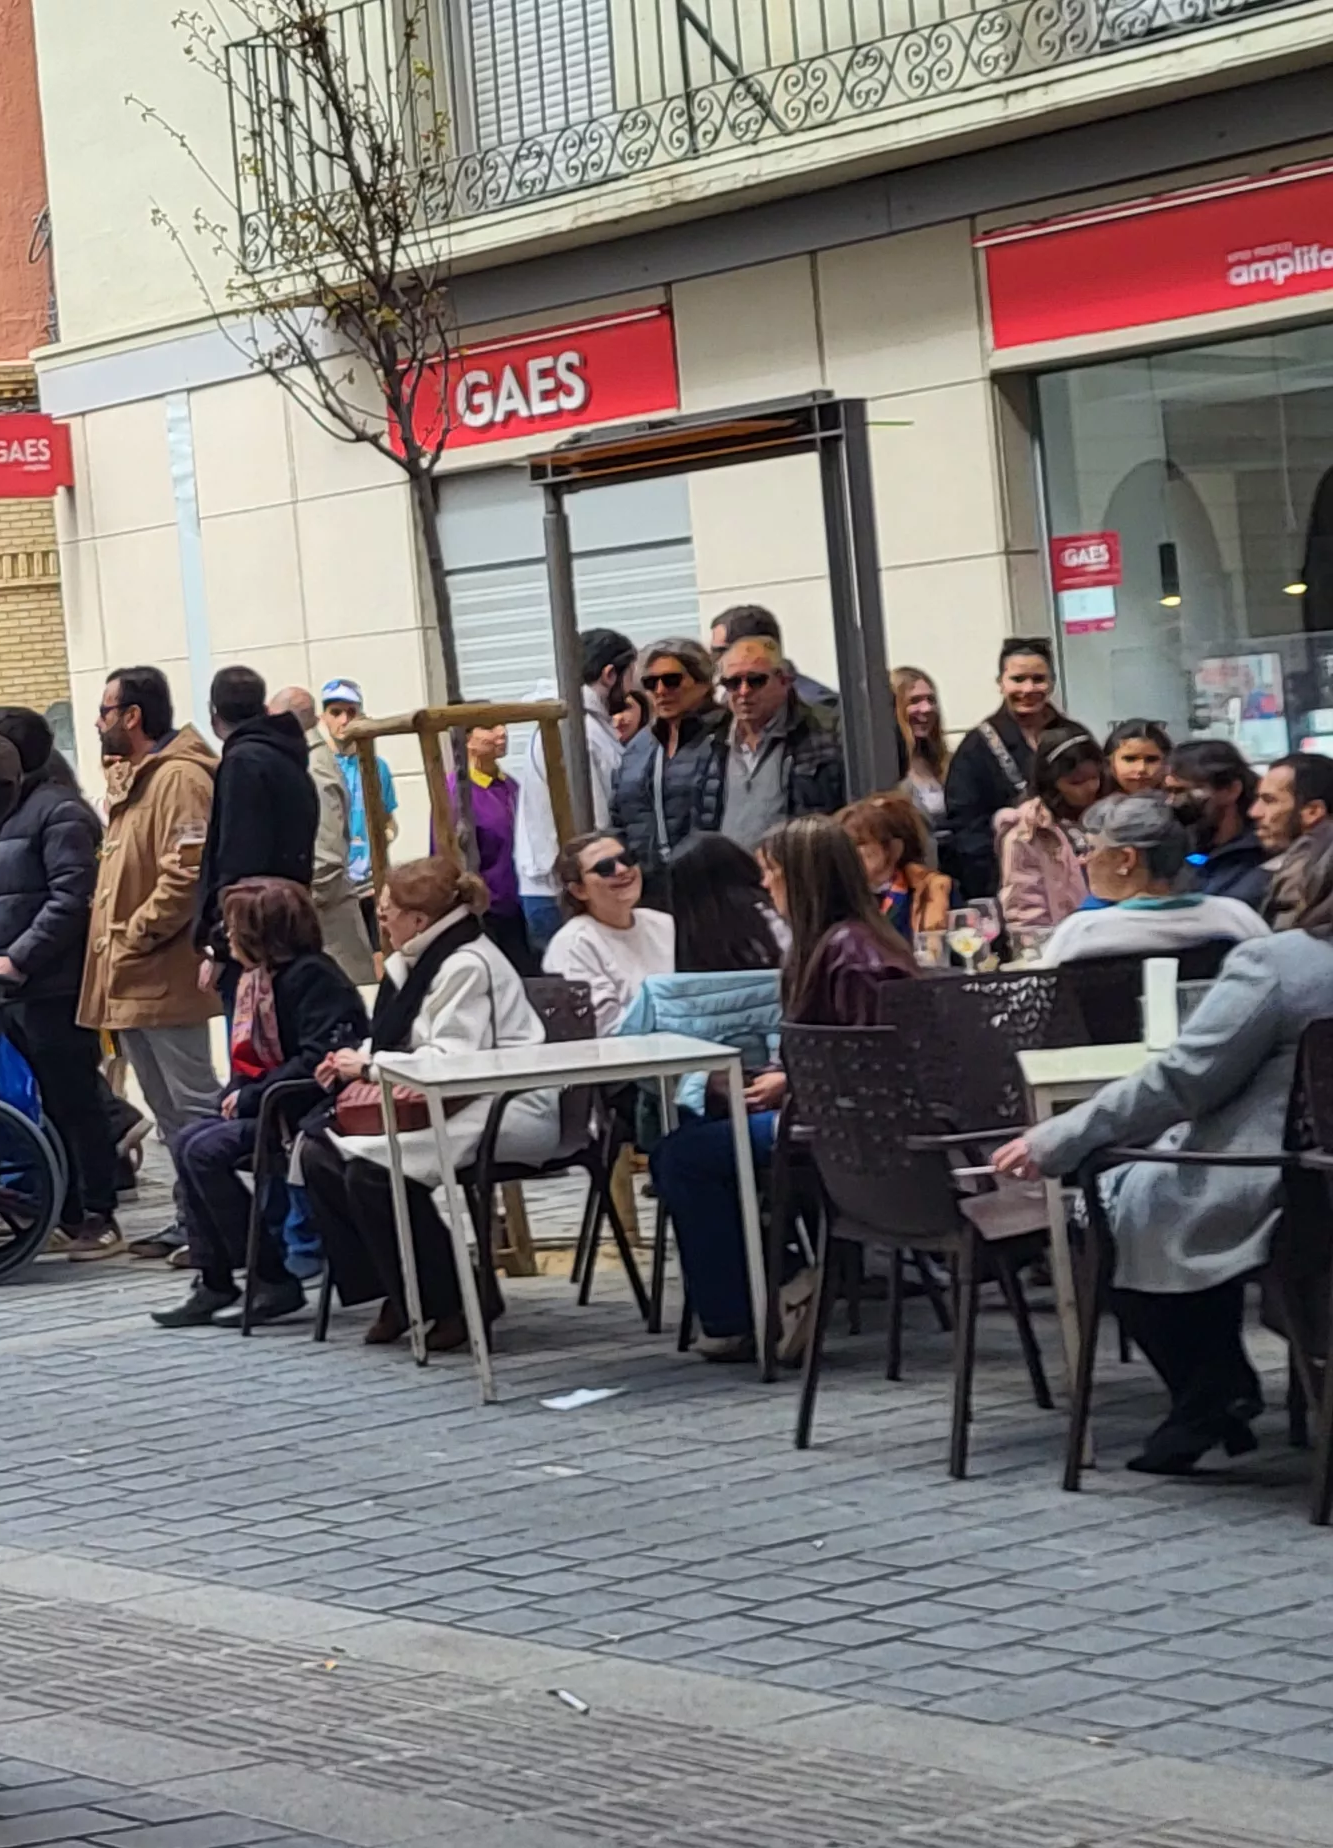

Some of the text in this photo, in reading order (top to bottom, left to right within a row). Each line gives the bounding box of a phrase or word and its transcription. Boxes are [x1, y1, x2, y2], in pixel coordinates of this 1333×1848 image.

[1227, 242, 1333, 286] amplifo
[455, 350, 586, 428] GAES
[1060, 543, 1110, 568] GAES
